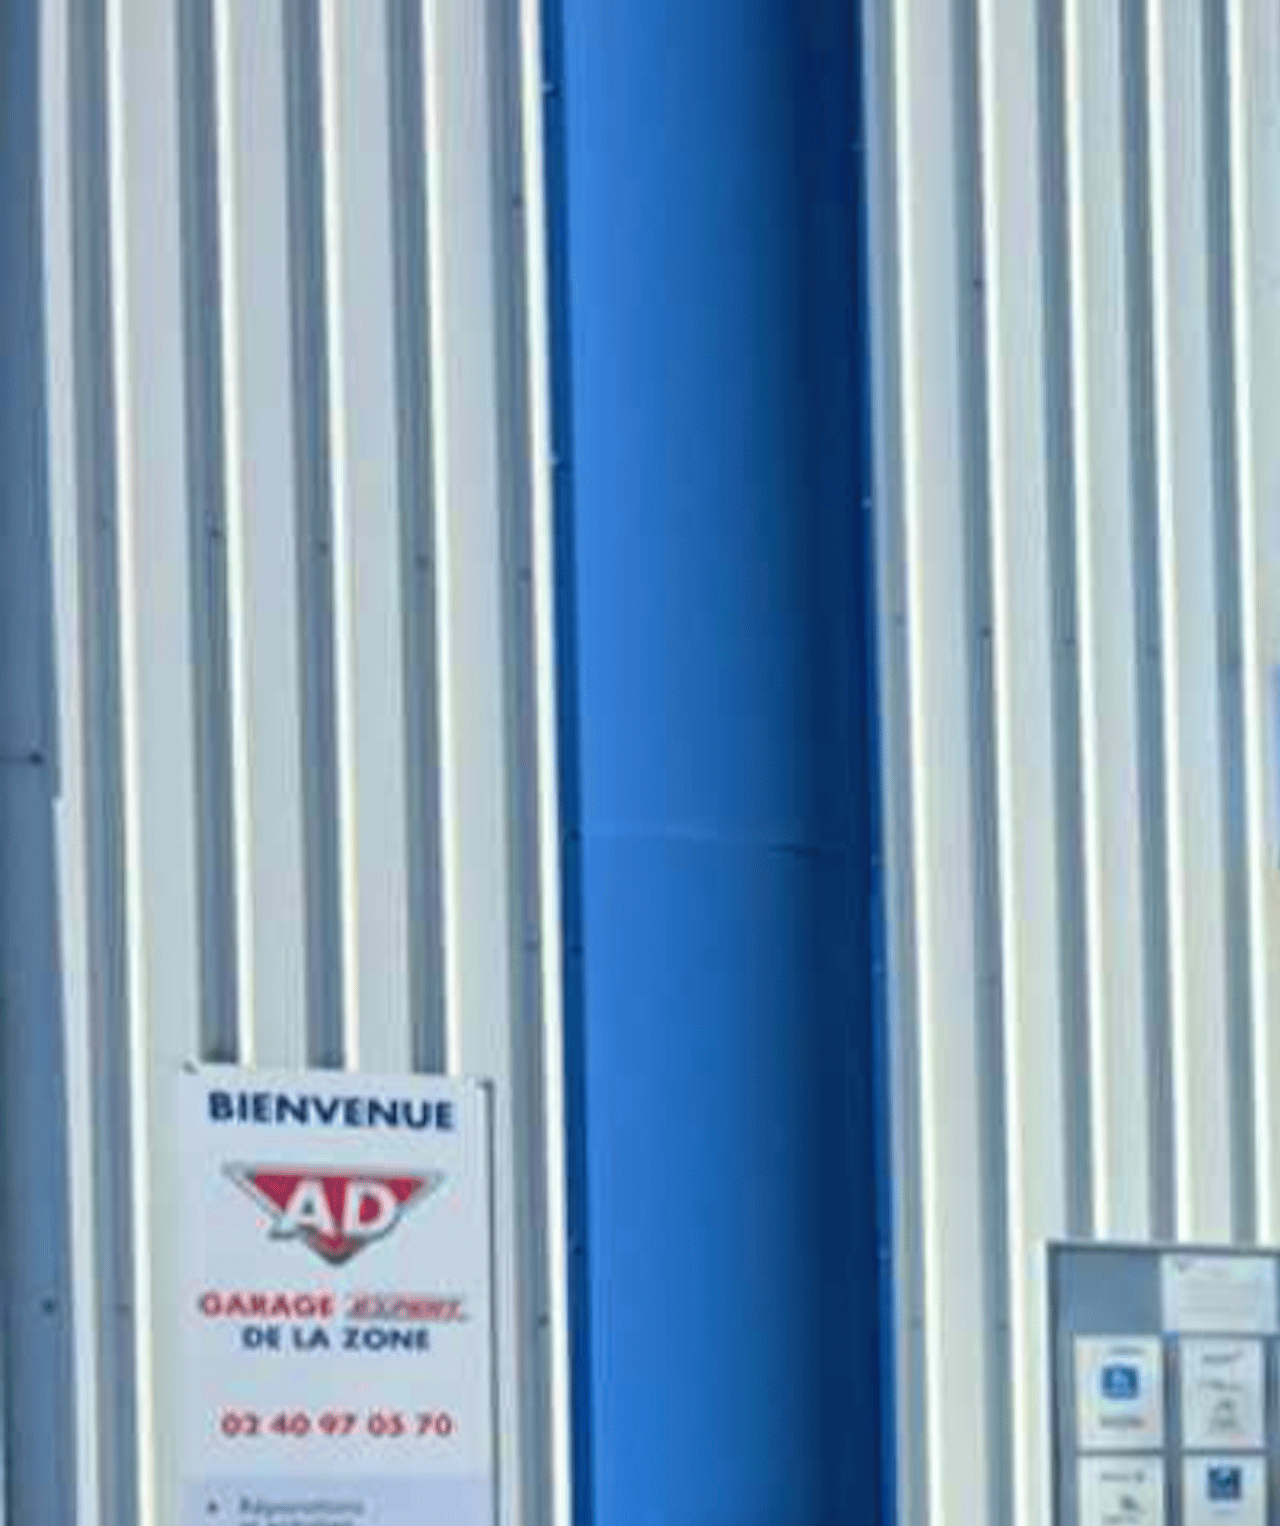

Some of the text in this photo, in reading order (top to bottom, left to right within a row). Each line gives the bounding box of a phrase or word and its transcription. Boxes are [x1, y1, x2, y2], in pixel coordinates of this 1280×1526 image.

[207, 1090, 456, 1131] BIENVENUE
[267, 1177, 398, 1237] AD
[199, 1293, 334, 1318] GARAGE
[241, 1324, 430, 1351] DE LA ZONE
[220, 1411, 453, 1438] 02 40 97 05 70
